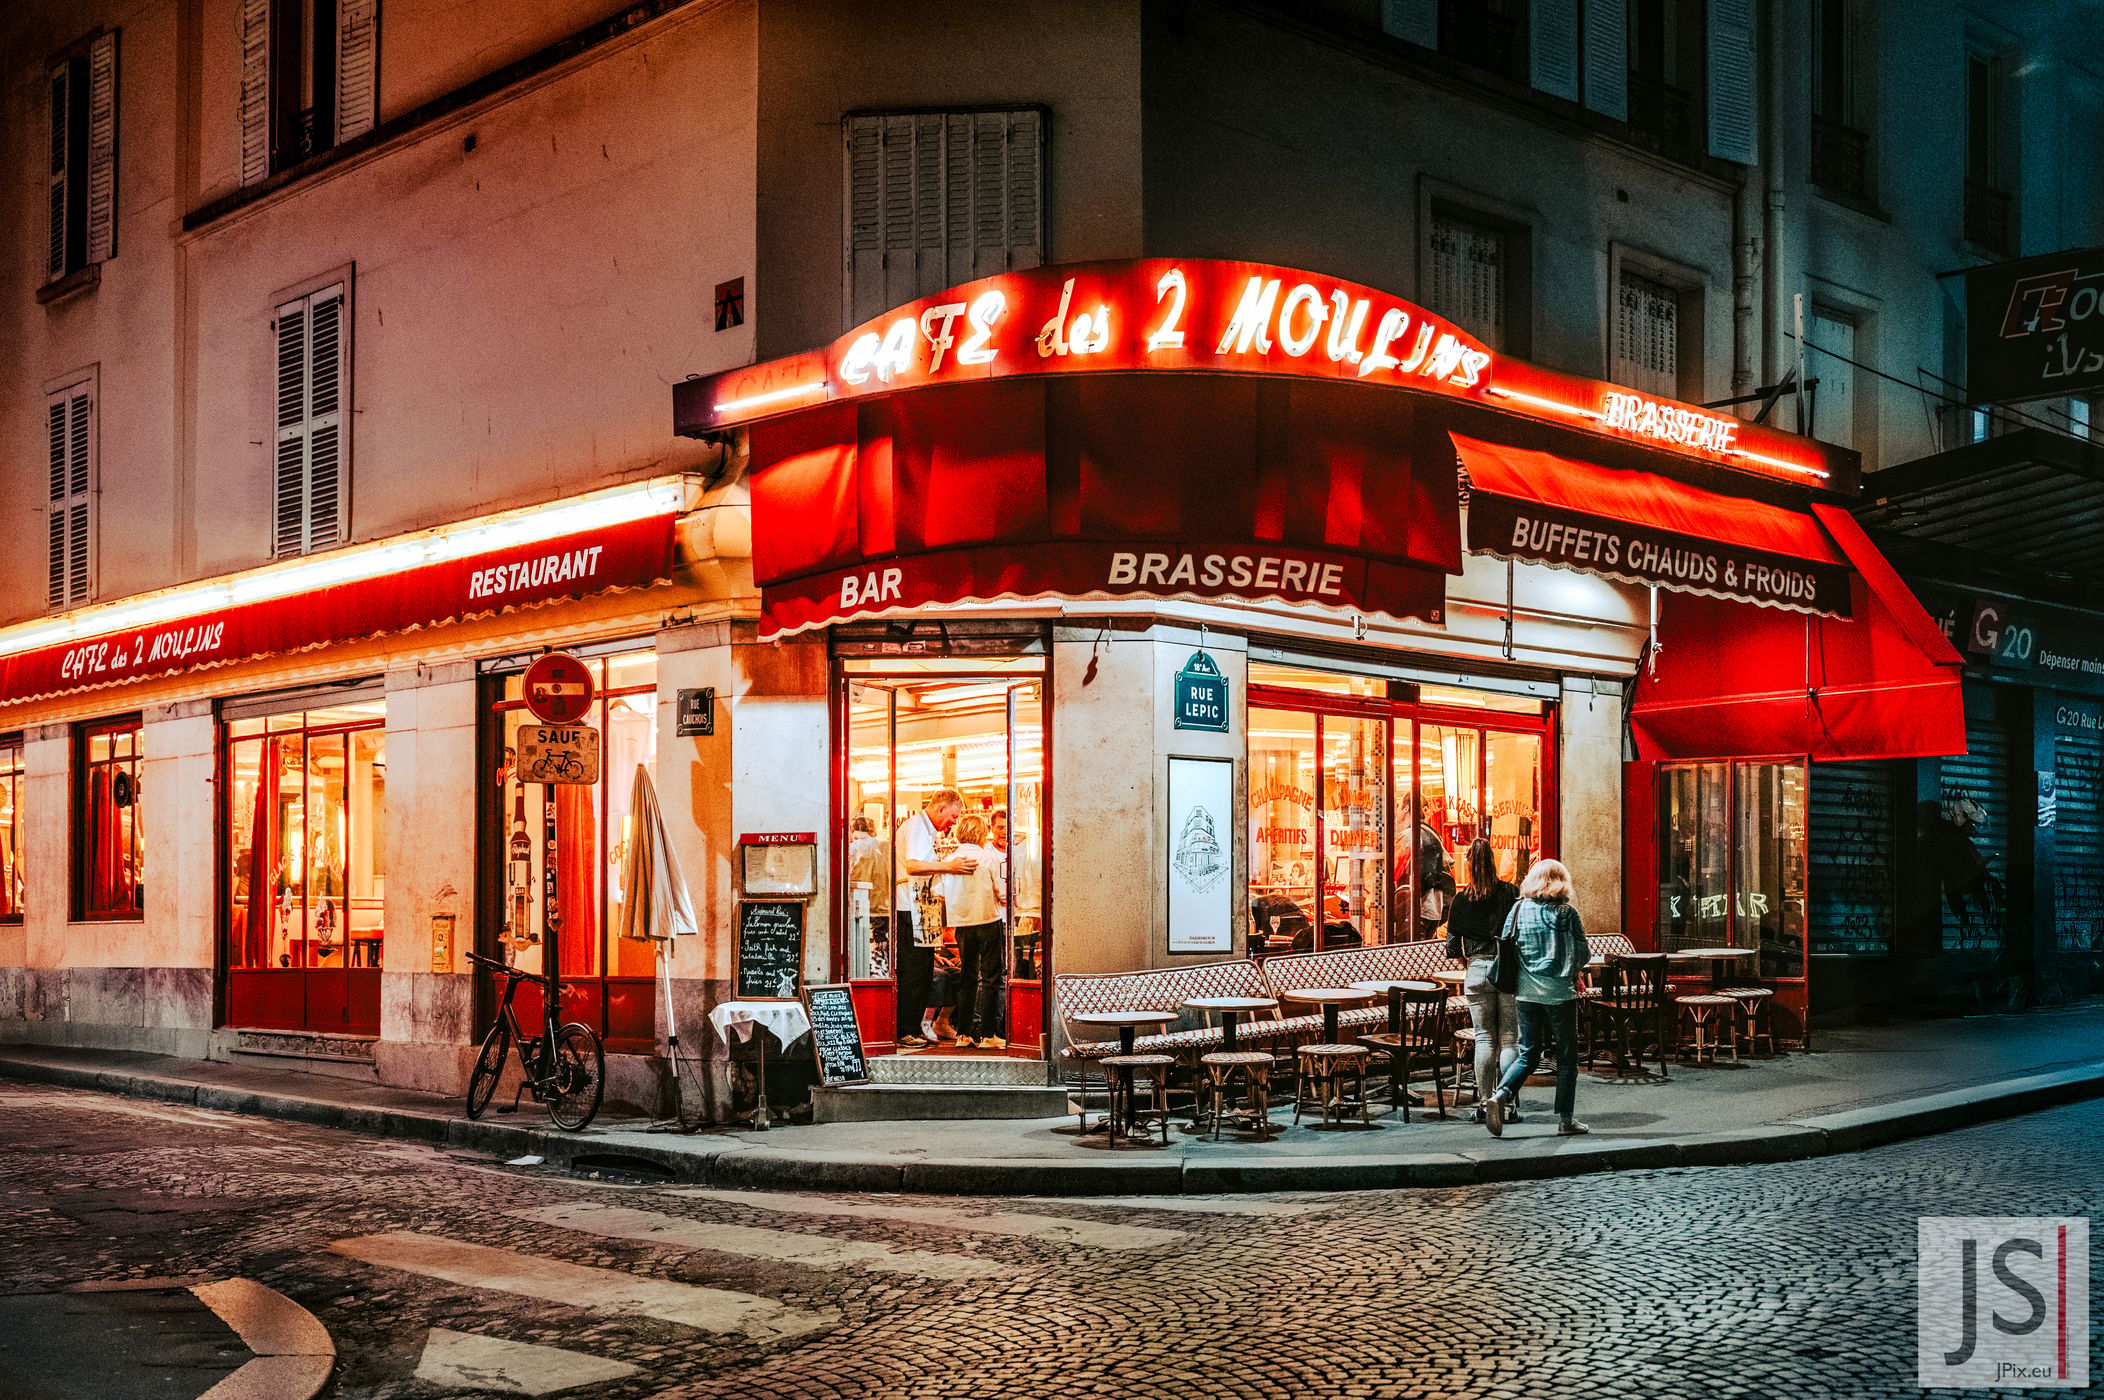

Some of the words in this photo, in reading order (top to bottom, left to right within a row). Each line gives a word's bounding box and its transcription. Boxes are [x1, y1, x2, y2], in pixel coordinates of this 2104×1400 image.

[840, 289, 1006, 385] CAFE
[1035, 277, 1111, 358] des
[1147, 268, 1187, 354] 2
[1214, 275, 1490, 388] MOULINS
[1606, 391, 1739, 455] BRASSERIE
[1511, 516, 1621, 565] BUFFETS
[1627, 539, 1718, 584] CHAUDS
[1723, 559, 1738, 587] &
[1744, 563, 1816, 601] FROIDS
[469, 545, 603, 599] RESTAURANT
[1107, 552, 1344, 596] BRASSERIE
[840, 567, 902, 608] BAR
[61, 641, 108, 680] CAFE
[111, 645, 127, 670] des
[132, 635, 144, 667] 2
[148, 621, 224, 663] MOULINS
[2040, 650, 2080, 671] Dépenser
[1190, 686, 1213, 701] RUE
[1185, 703, 1219, 718] LEPIC
[2056, 706, 2079, 727] G20
[2081, 712, 2097, 729] Rue
[537, 729, 581, 744] SAUF
[1250, 783, 1314, 812] CHAMPAGNE
[1331, 789, 1375, 811] LUNCH
[758, 834, 799, 843] MENU
[1330, 829, 1379, 848] DINNER
